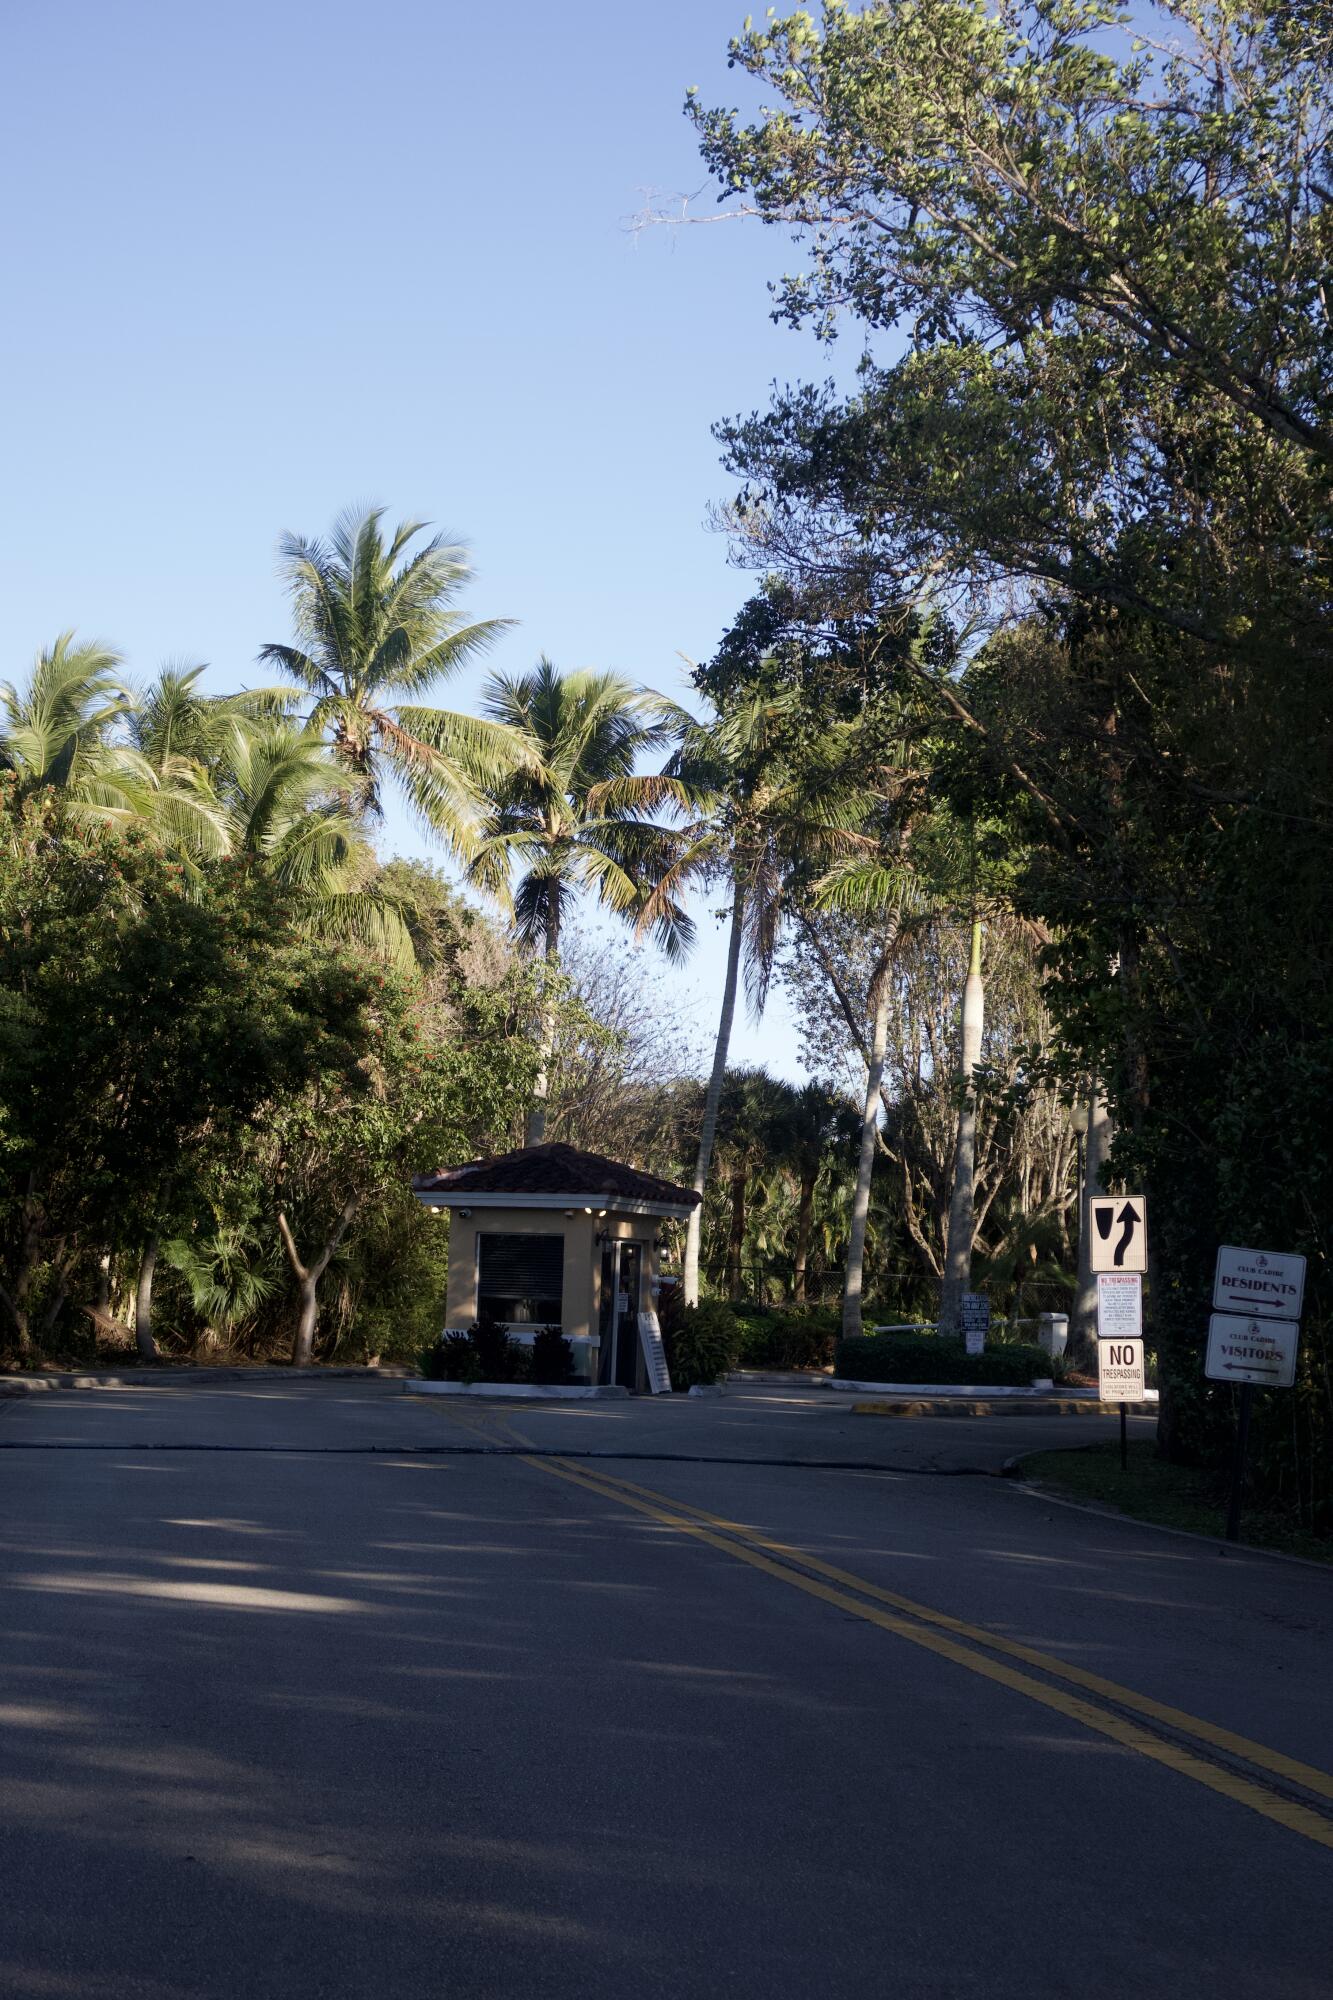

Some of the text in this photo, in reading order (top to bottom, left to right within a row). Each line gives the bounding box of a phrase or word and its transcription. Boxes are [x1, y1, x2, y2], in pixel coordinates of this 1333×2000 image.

[1222, 1276, 1297, 1296] RESIDENTS
[1110, 1345, 1134, 1366] NO
[1220, 1345, 1284, 1362] VISITORS
[1102, 1369, 1140, 1379] TRESPASSING
